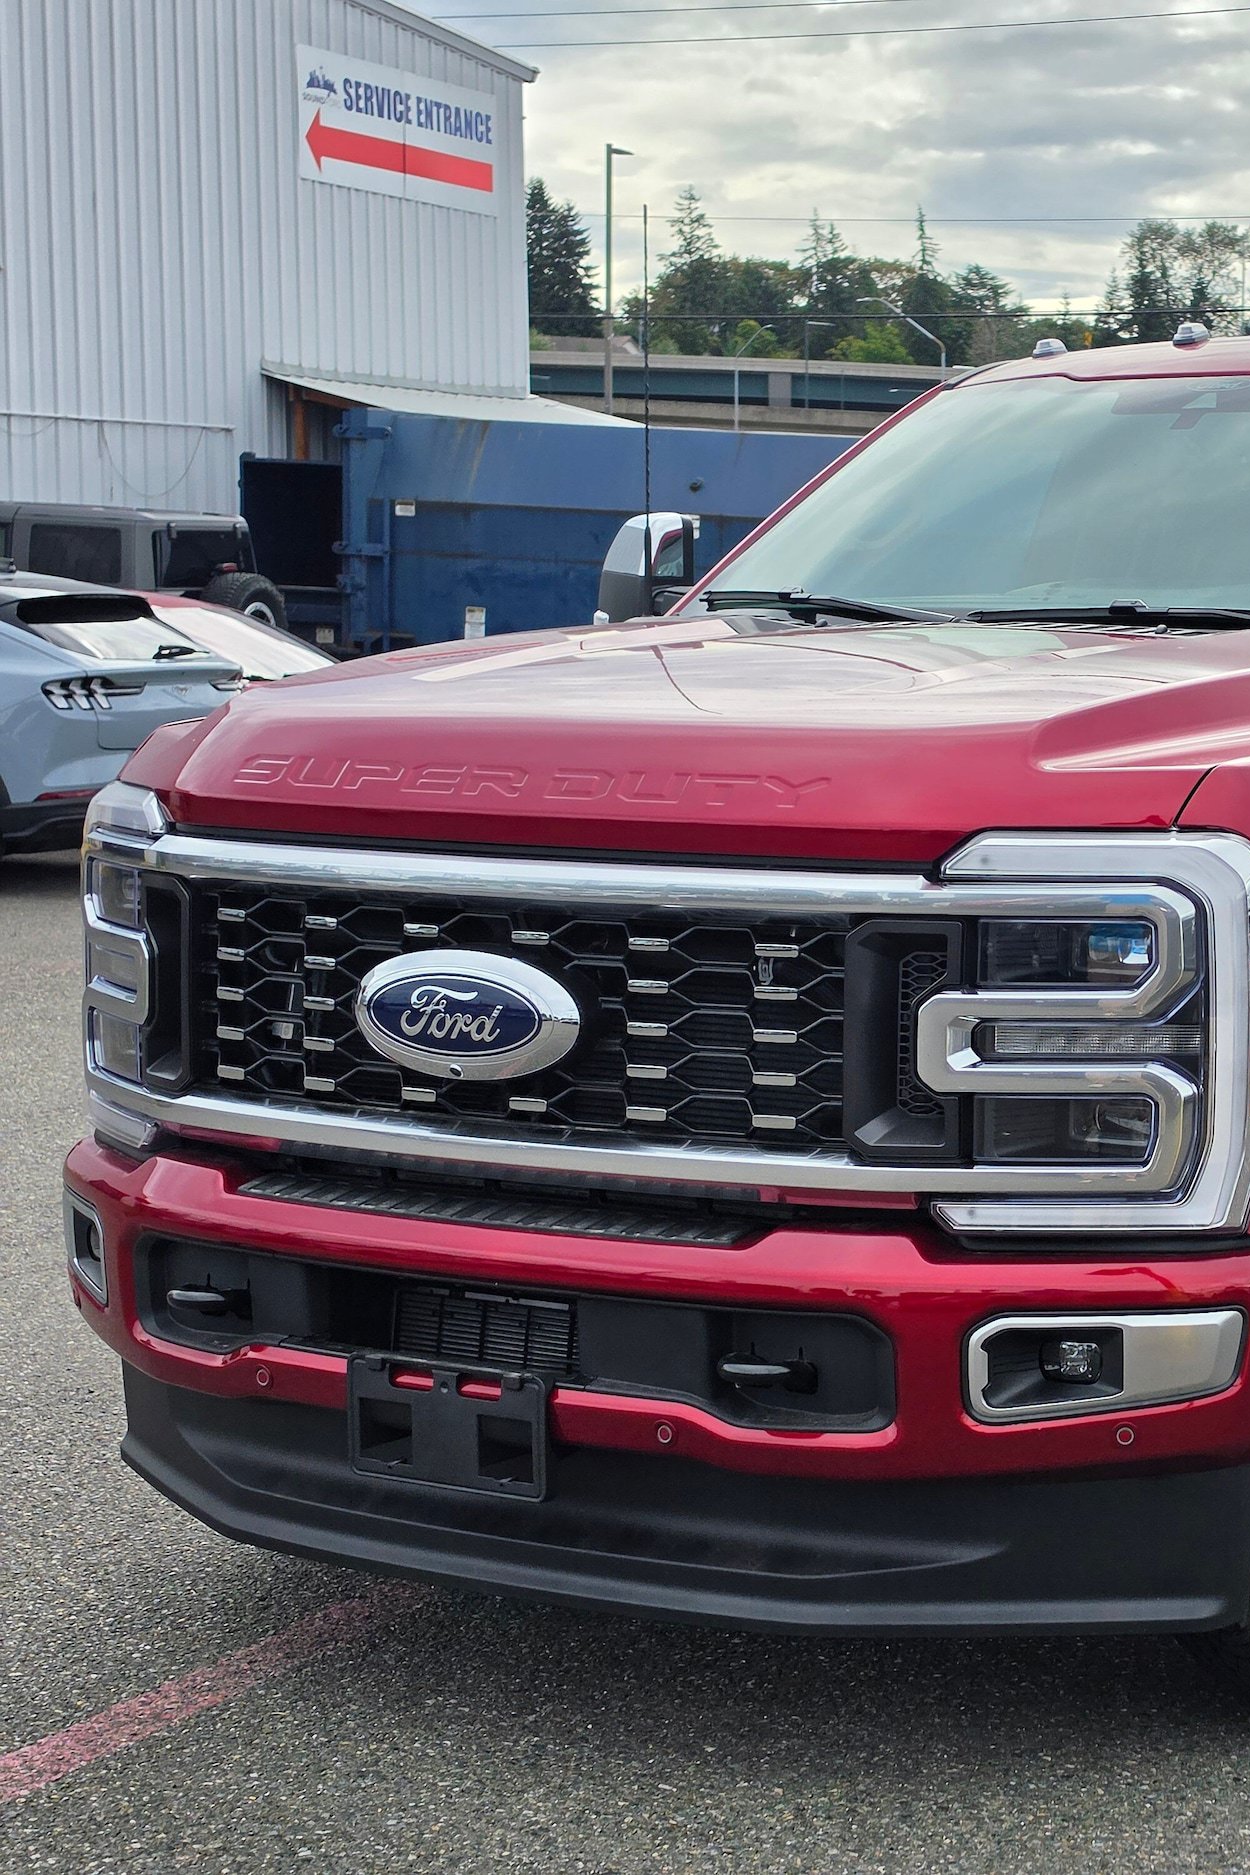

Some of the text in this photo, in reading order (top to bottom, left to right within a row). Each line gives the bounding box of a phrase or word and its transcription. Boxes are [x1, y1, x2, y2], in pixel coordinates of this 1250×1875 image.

[342, 77, 493, 145] SERVICE ENTRANCE
[234, 753, 832, 809] SUPER DUTY
[400, 985, 504, 1043] Ford
